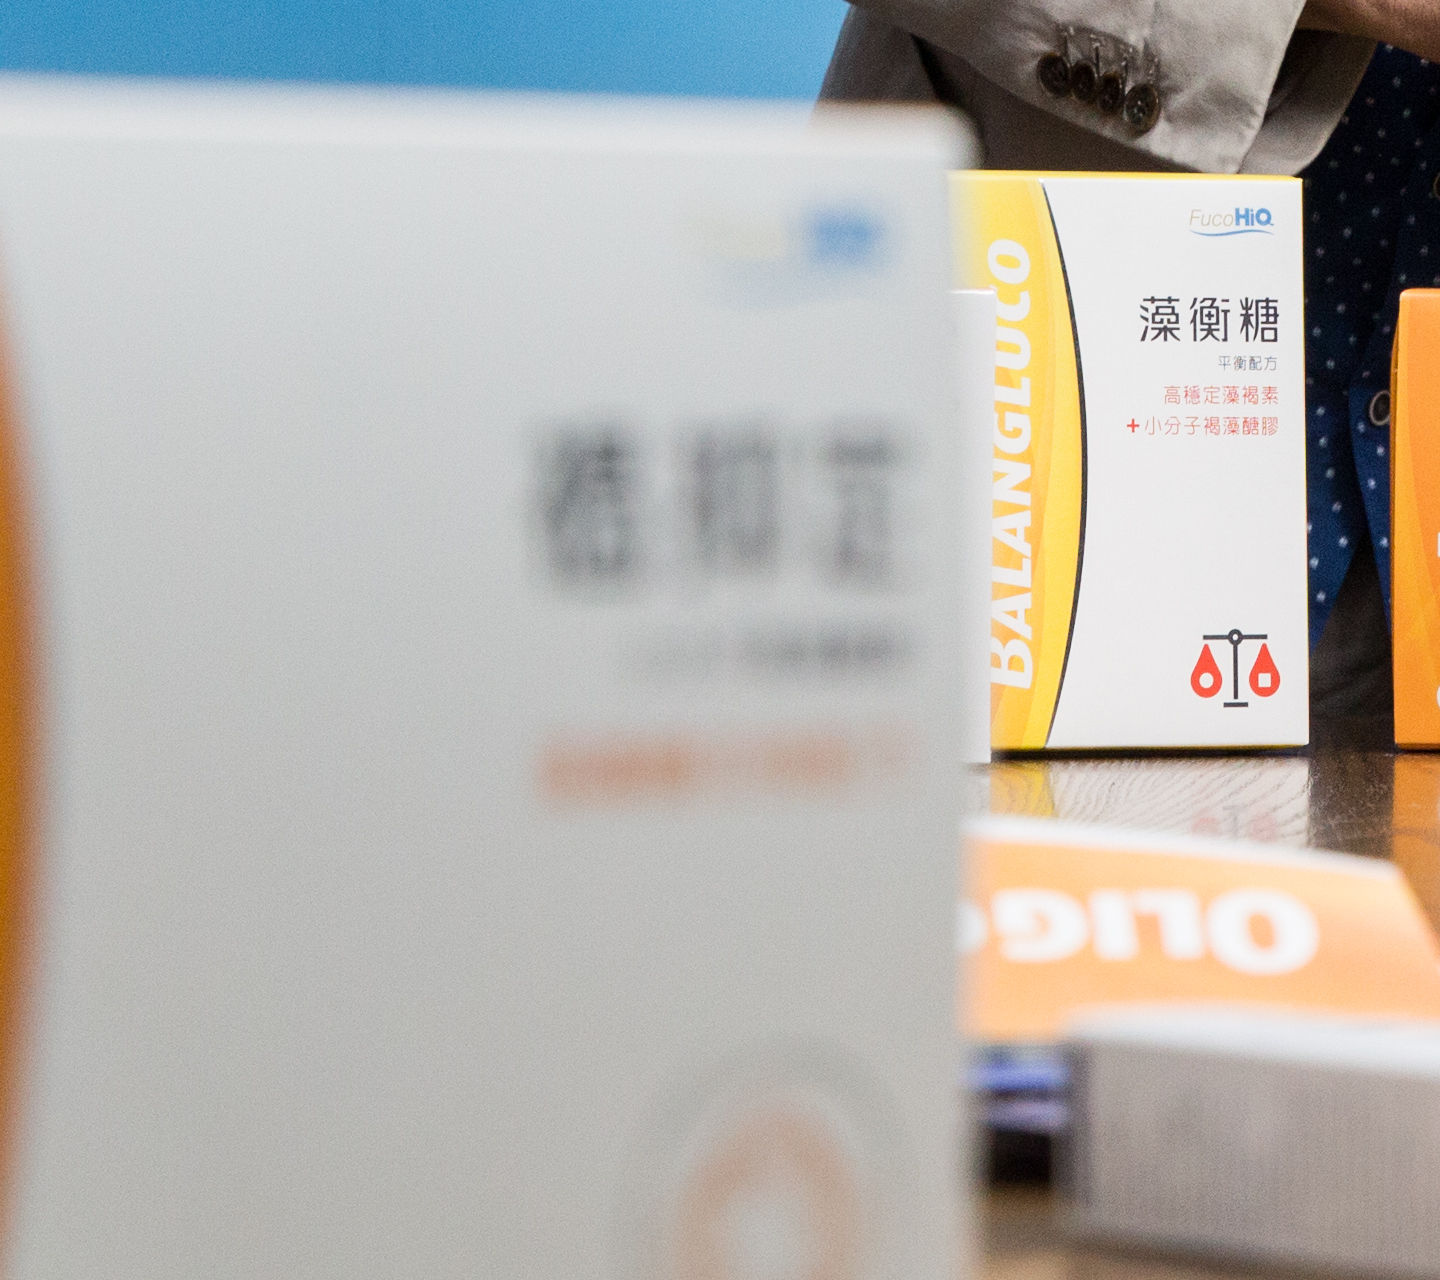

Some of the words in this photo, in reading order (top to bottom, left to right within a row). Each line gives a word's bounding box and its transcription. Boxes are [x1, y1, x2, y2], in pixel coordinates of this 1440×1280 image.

[1189, 207, 1275, 227] FucoHiQ
[1139, 295, 1280, 343] 藻衡糖
[1218, 355, 1278, 371] 平衡配方
[1163, 385, 1279, 405] 高穩定藻褐素
[987, 237, 1033, 690] BALANGLUCO
[960, 884, 1320, 976] OLIG
